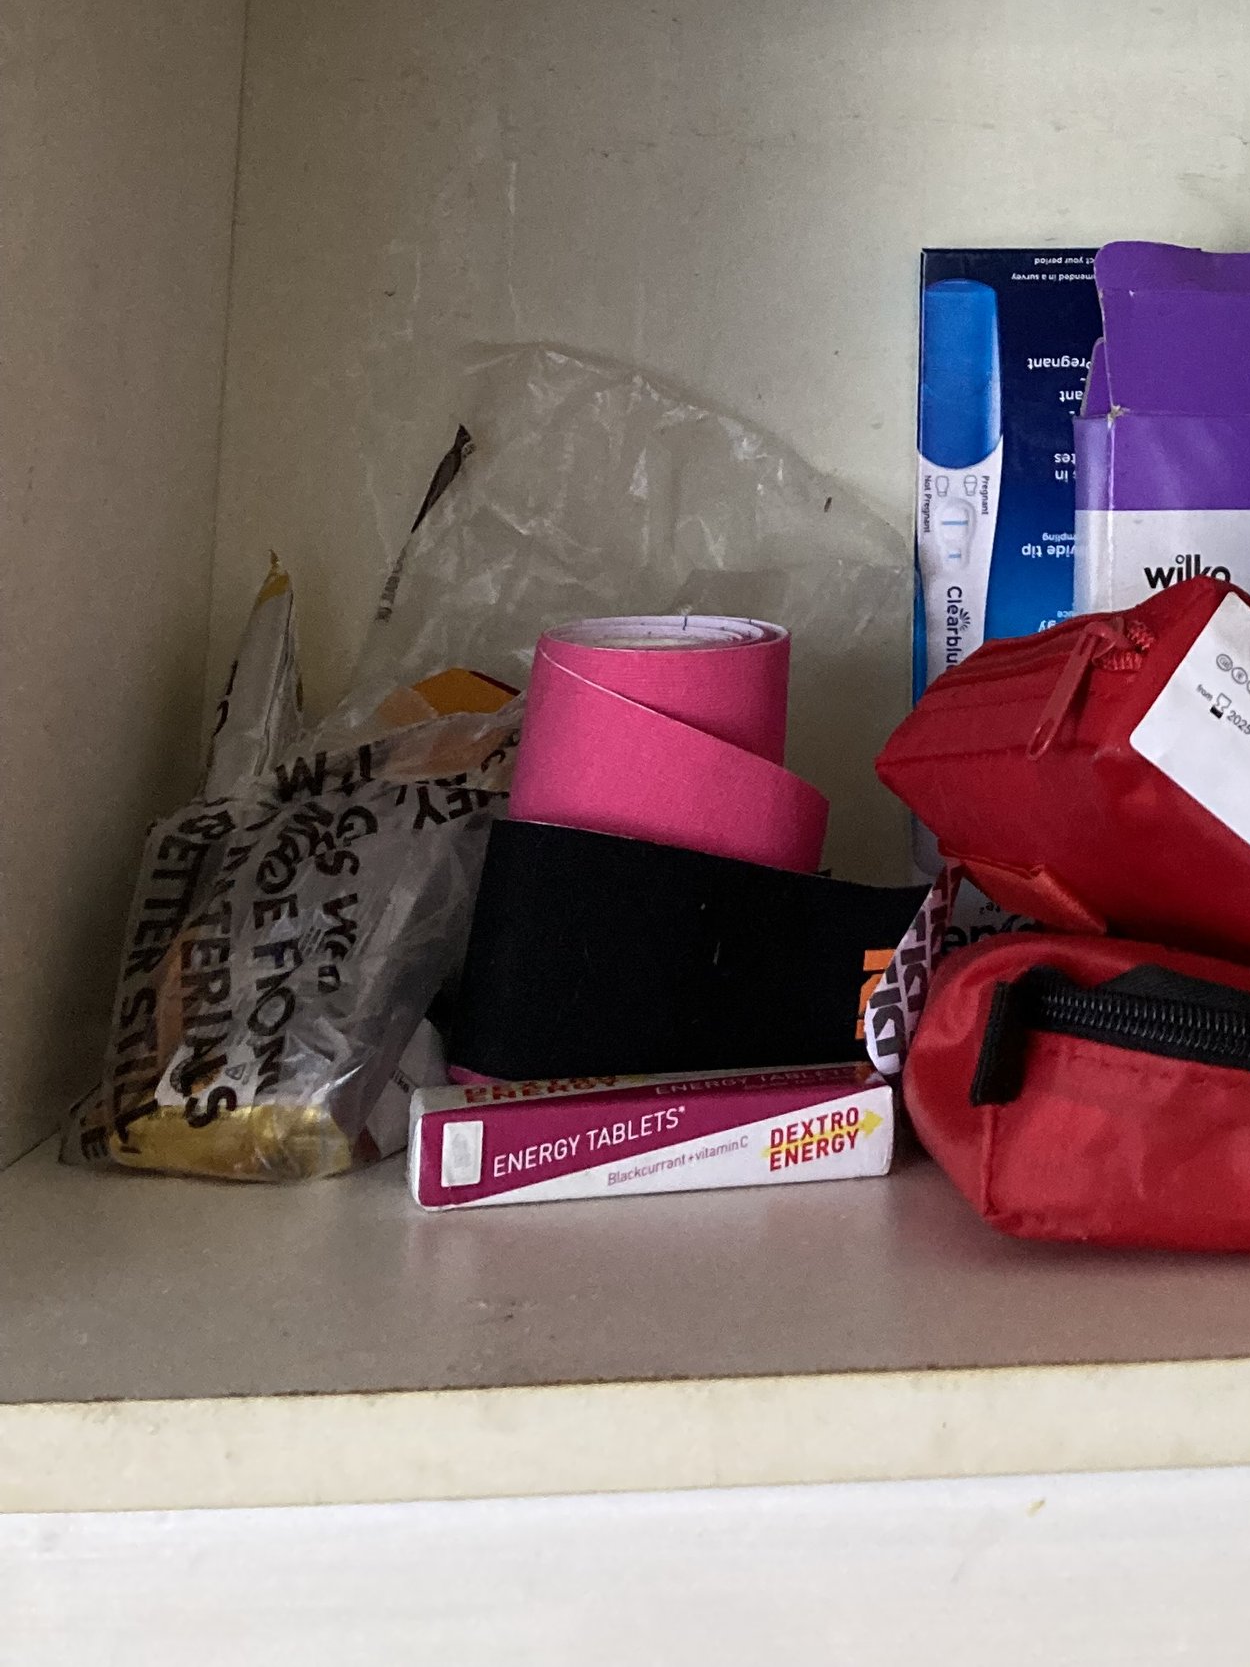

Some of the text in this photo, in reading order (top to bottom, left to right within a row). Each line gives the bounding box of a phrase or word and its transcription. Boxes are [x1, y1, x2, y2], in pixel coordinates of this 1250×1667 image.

[1034, 257, 1063, 265] period
[1064, 258, 1084, 266] your
[981, 475, 990, 515] Pregnant
[923, 496, 932, 533] Pregnant
[1021, 543, 1043, 557] tip
[1195, 683, 1215, 701] from
[769, 1106, 860, 1150] DEXTRO
[493, 1134, 581, 1178] ENERGY
[768, 1128, 860, 1173] ENERGY
[607, 1153, 686, 1187] Blackcurrant
